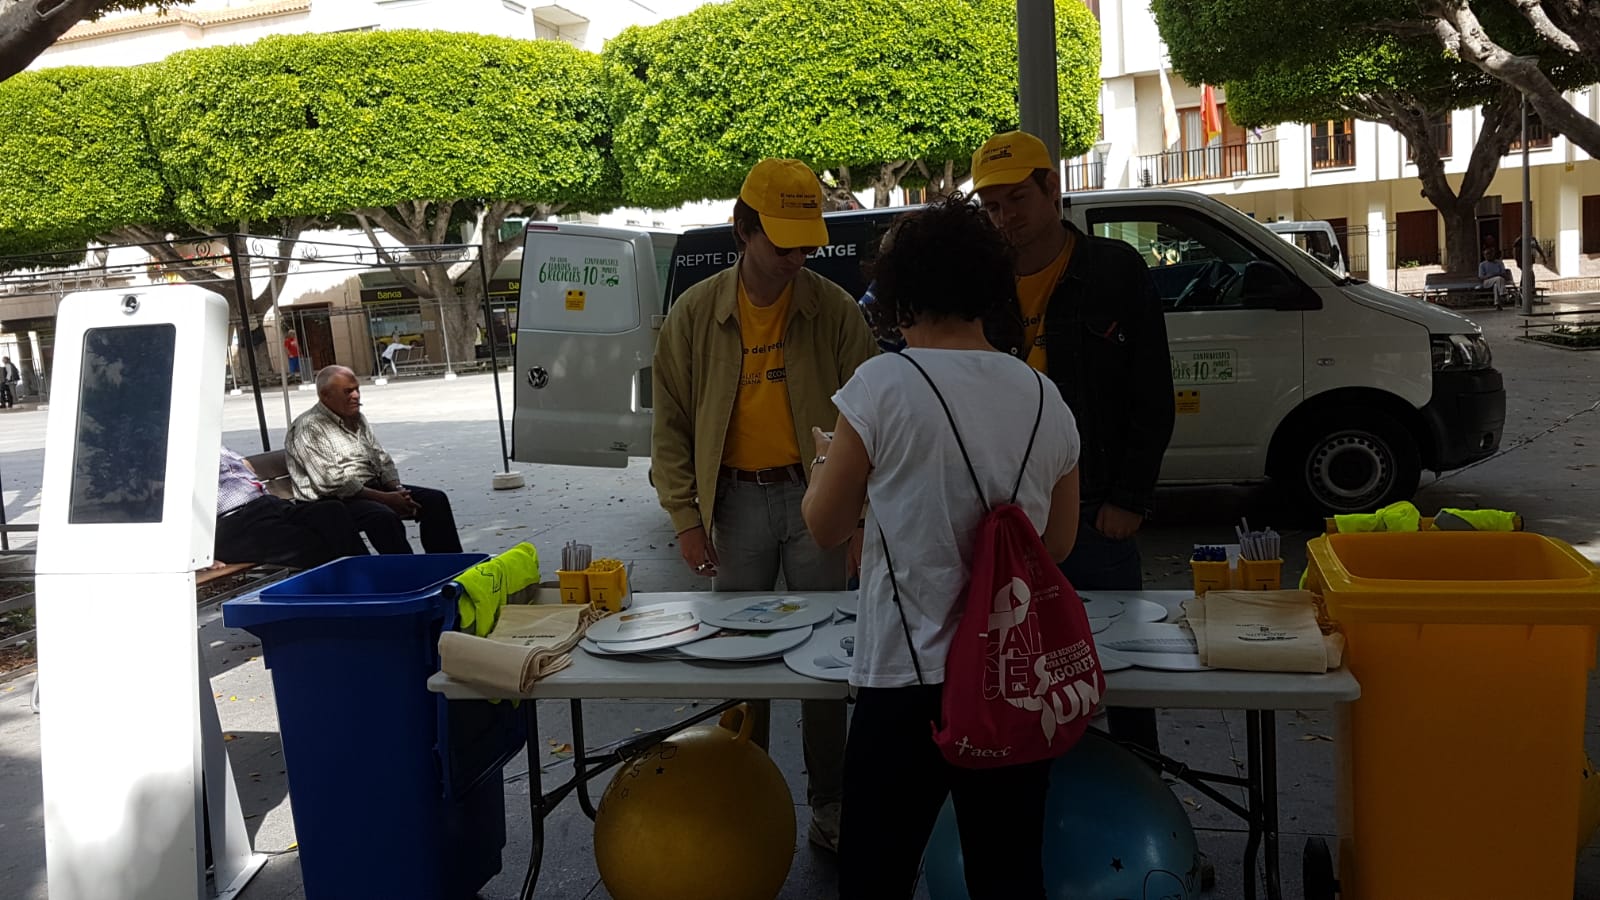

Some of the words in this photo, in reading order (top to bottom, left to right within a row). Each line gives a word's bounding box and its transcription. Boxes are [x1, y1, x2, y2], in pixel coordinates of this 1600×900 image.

[676, 252, 722, 267] REPTE
[539, 262, 547, 283] 6
[584, 266, 598, 285] 10
[751, 344, 766, 354] del
[1192, 361, 1209, 381] 10
